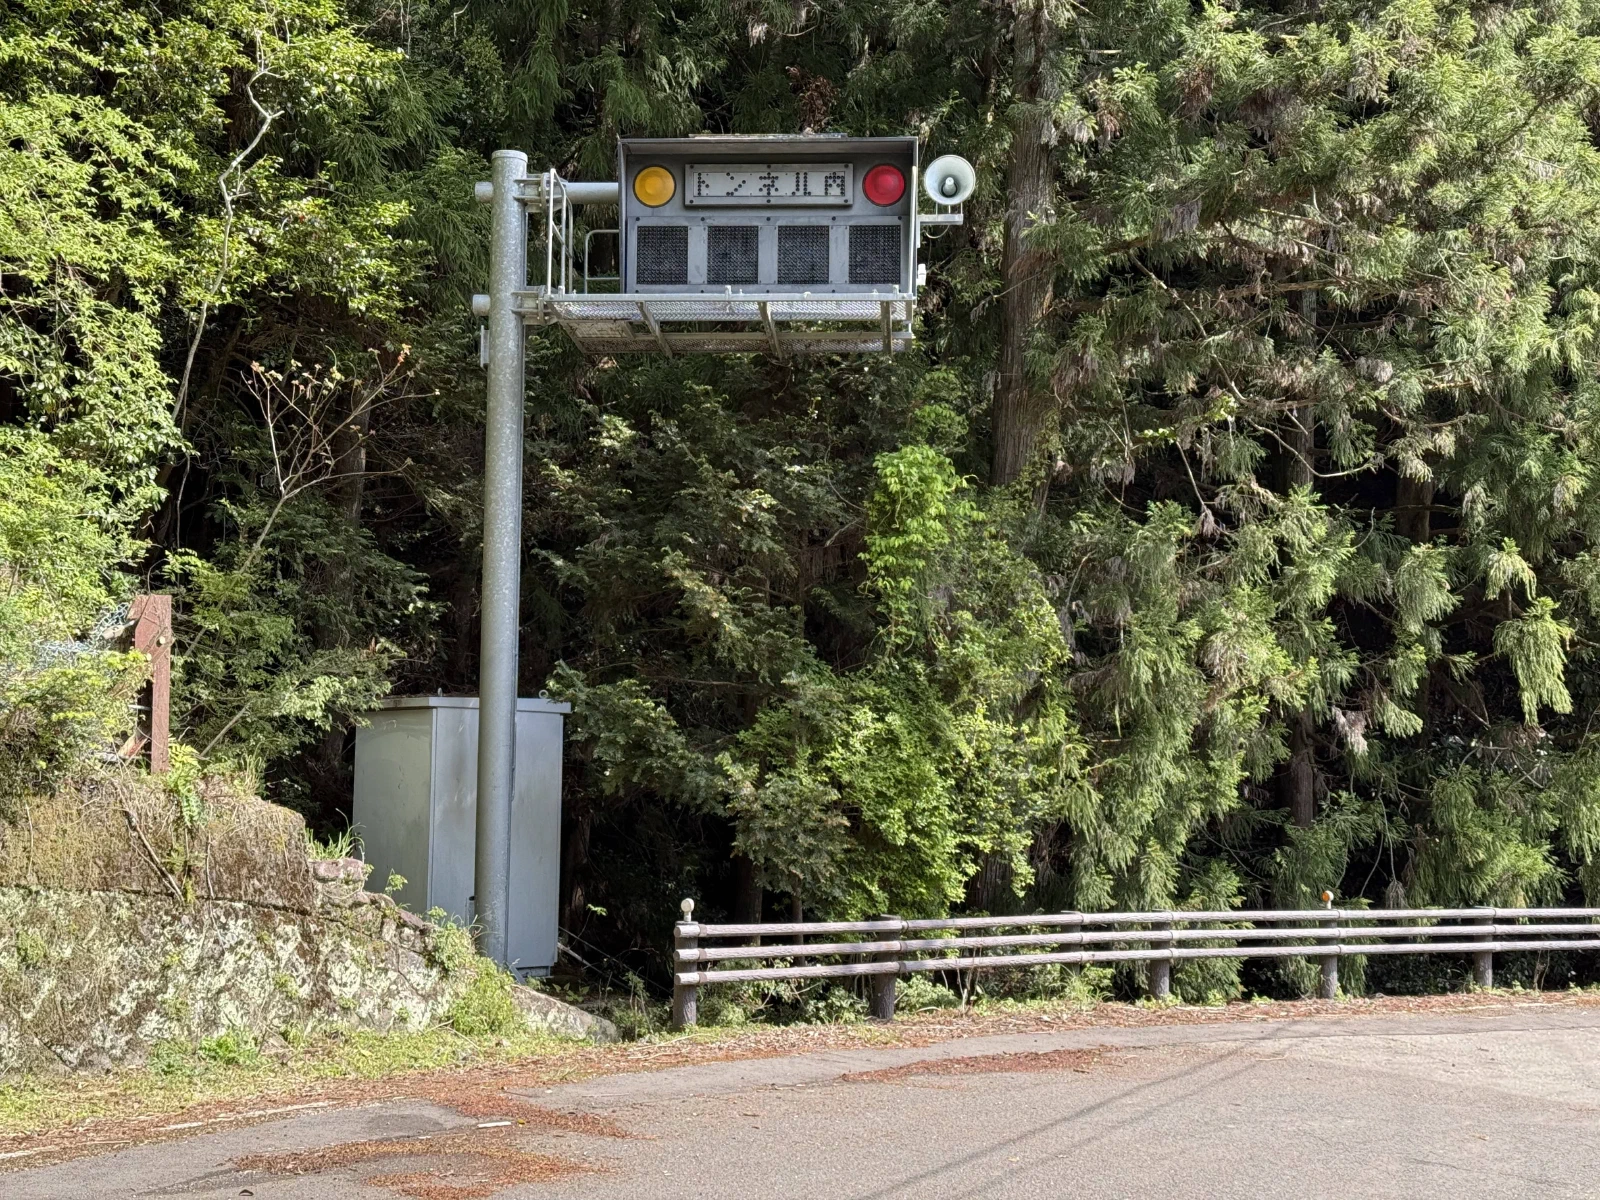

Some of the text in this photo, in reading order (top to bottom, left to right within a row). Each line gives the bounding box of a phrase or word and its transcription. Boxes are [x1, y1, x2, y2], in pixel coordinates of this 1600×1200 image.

[697, 171, 845, 196] トンネル内
